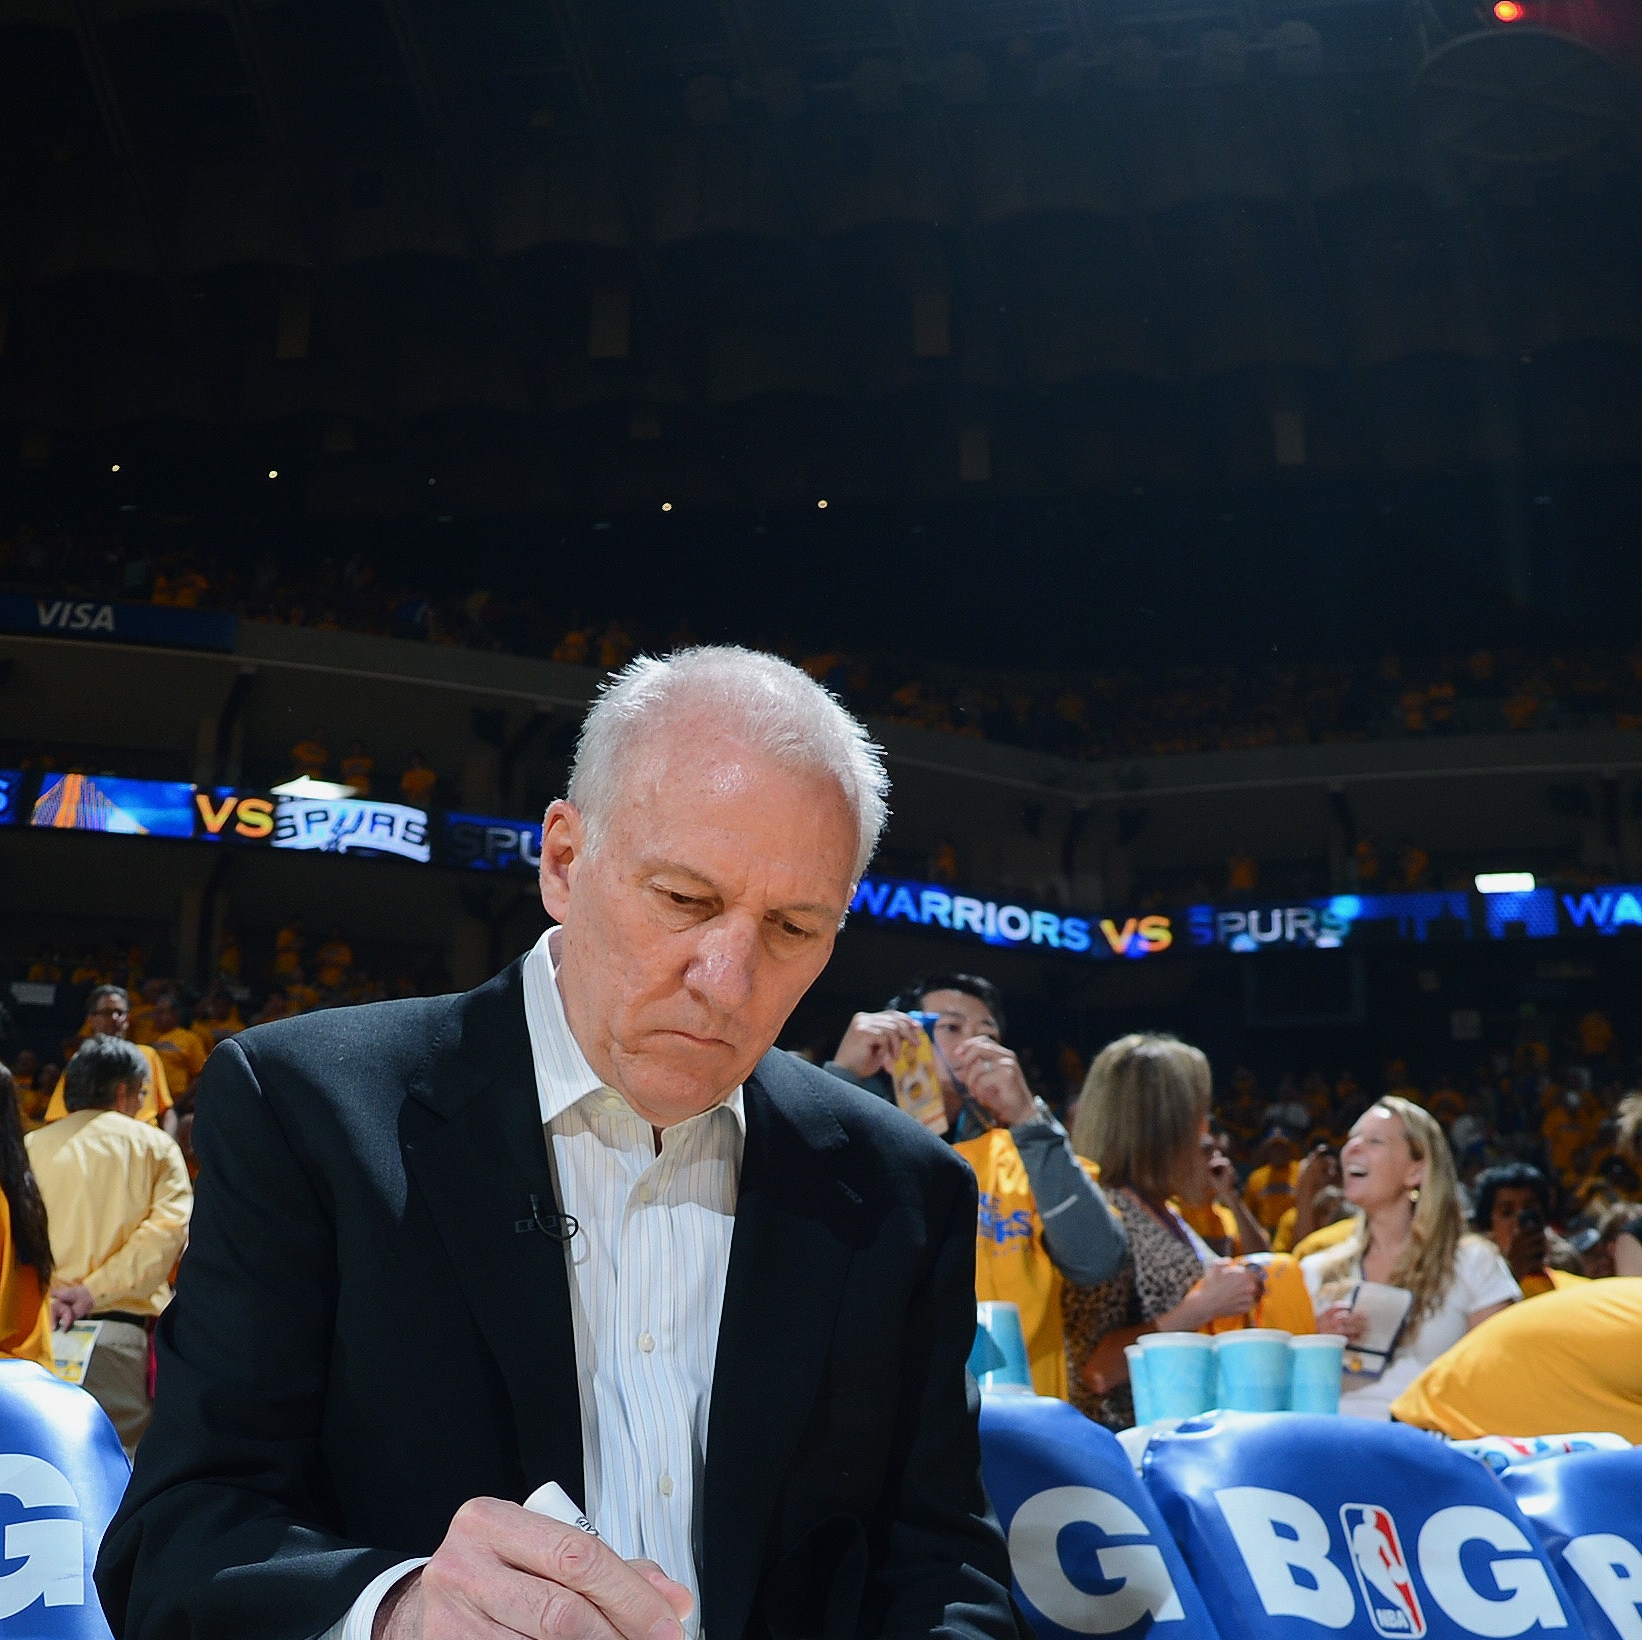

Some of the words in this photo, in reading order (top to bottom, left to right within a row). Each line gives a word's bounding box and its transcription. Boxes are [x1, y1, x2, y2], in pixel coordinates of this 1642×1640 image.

[33, 599, 116, 634] VISA
[196, 793, 275, 839] VS
[852, 880, 1092, 953] WARRIORS
[1099, 914, 1174, 955] VS
